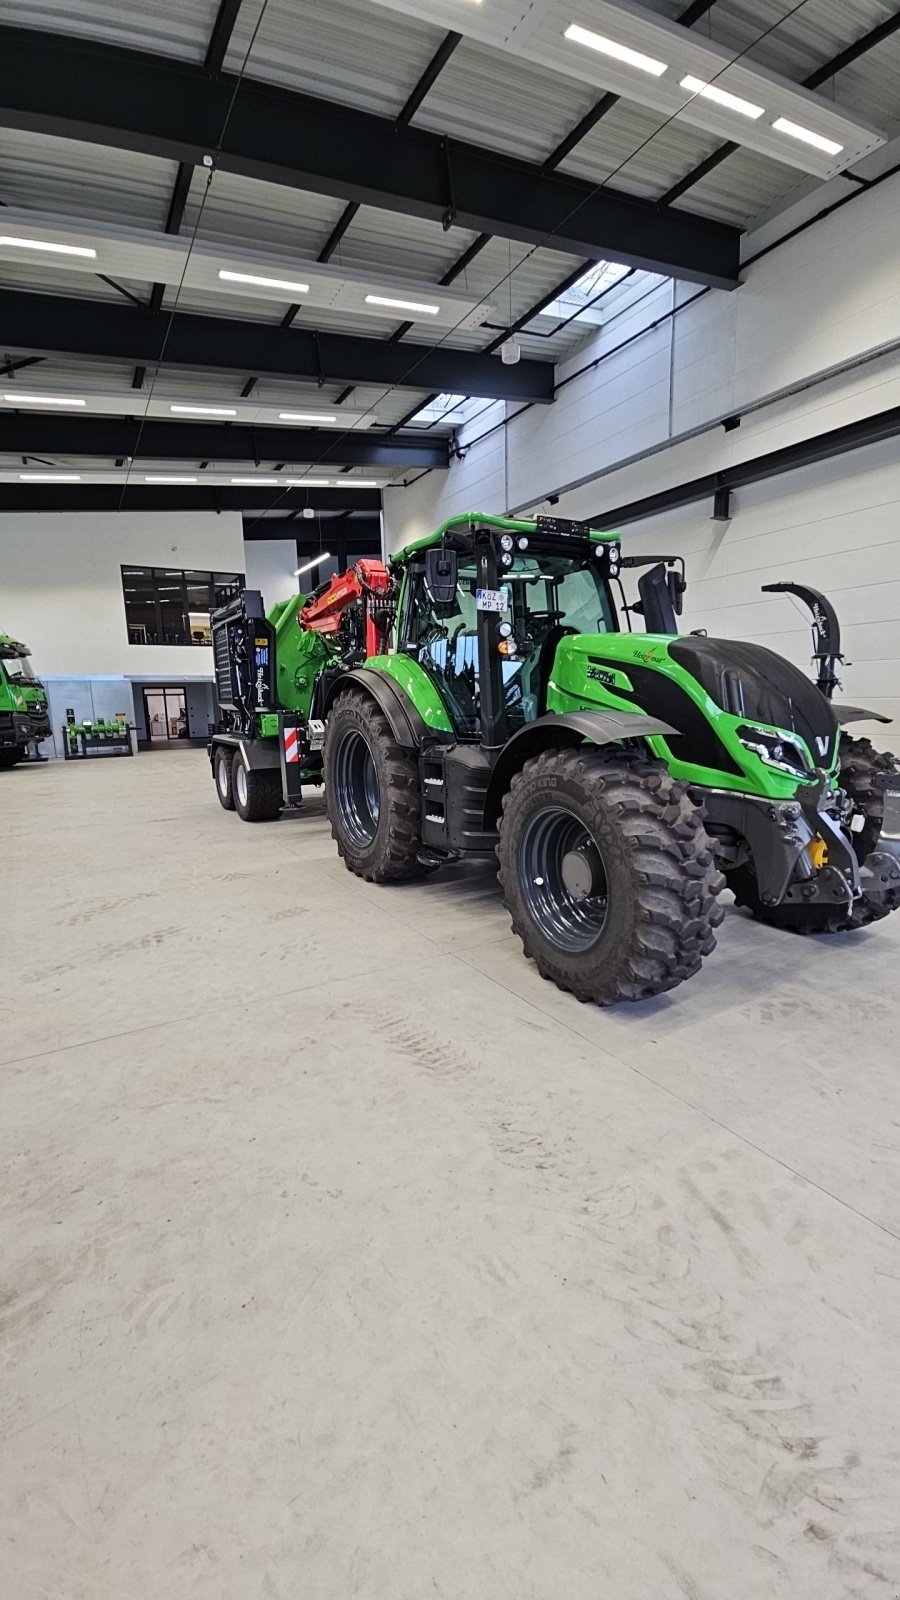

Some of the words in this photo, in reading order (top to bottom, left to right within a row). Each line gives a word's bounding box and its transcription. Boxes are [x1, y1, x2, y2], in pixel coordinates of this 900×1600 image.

[482, 590, 497, 601] KÖZ
[482, 600, 492, 610] MP
[496, 602, 505, 611] 12
[815, 735, 830, 757] V
